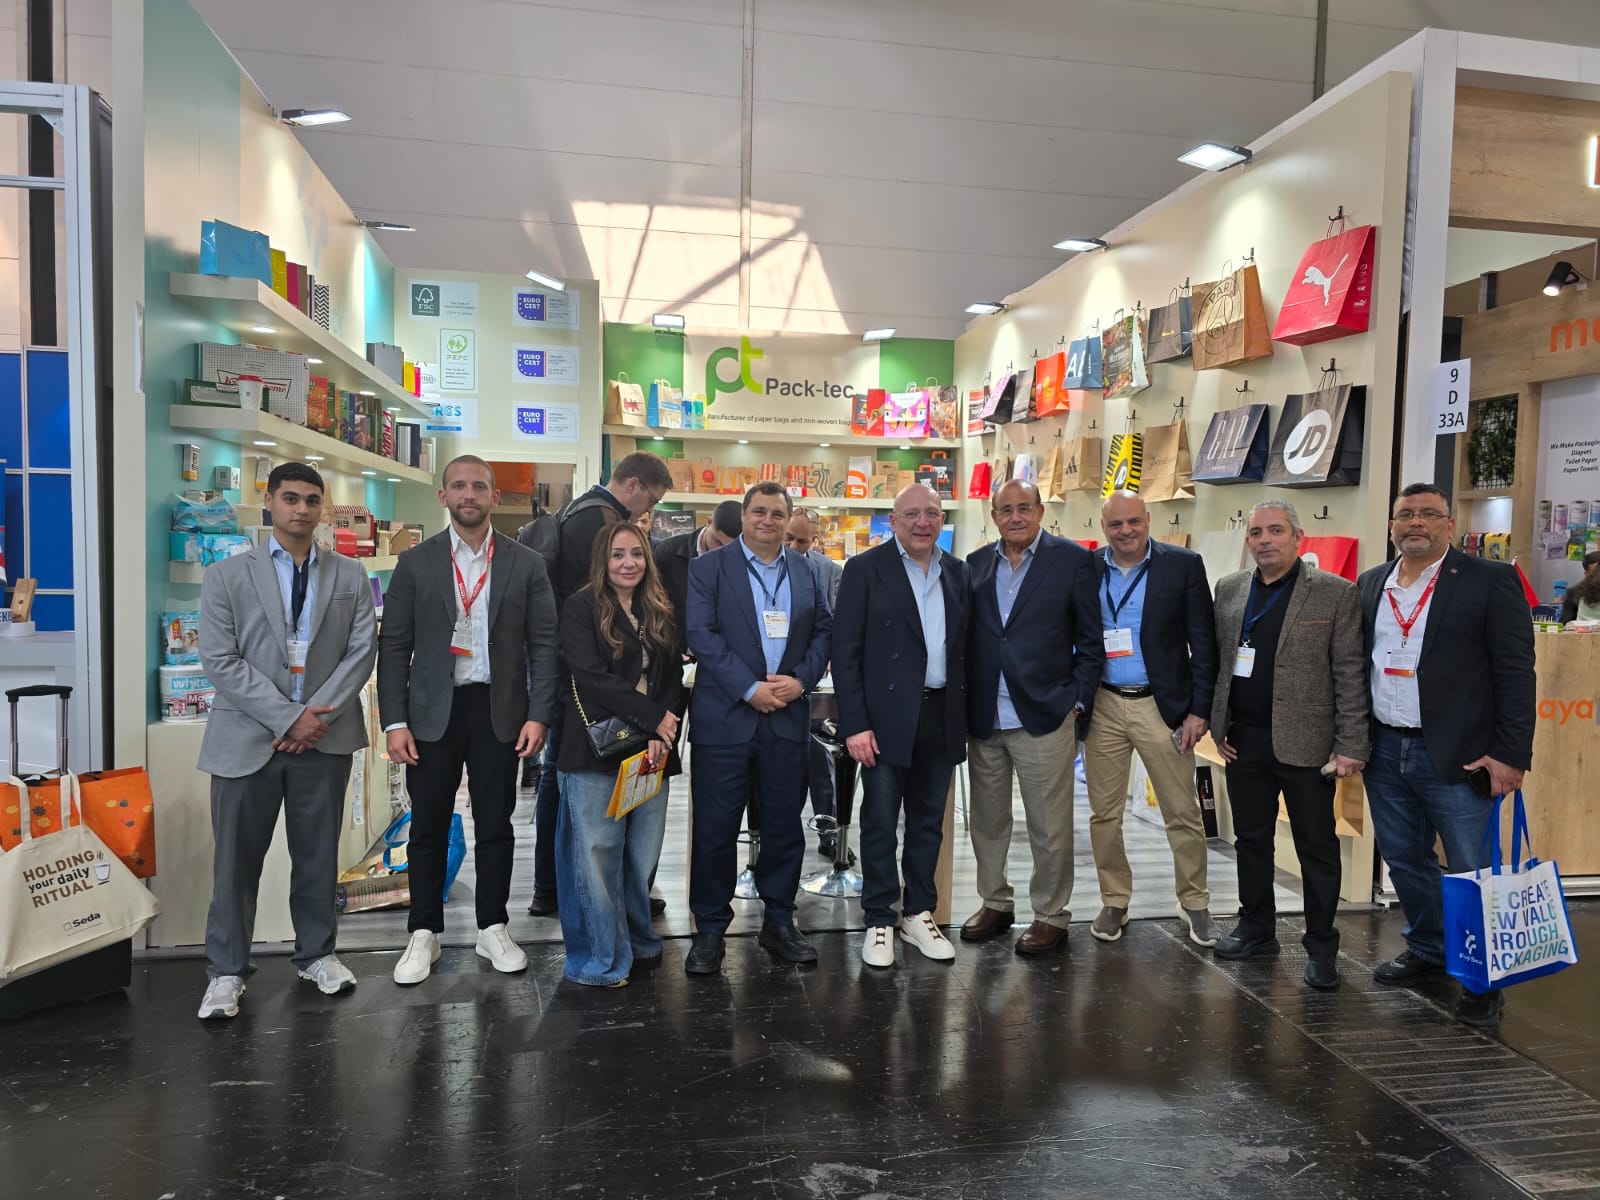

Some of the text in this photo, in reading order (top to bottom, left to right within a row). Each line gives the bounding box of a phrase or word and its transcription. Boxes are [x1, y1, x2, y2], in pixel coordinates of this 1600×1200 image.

[765, 377, 854, 398] Pack-tec
[1450, 368, 1459, 383] 9
[1448, 390, 1458, 405] D
[1438, 411, 1465, 428] 33A
[1207, 415, 1249, 460] GAP
[1288, 424, 1327, 460] JD
[172, 678, 209, 689] white
[22, 850, 95, 883] HOLDING
[28, 866, 90, 894] your daily
[32, 879, 94, 908] RITUAL
[72, 912, 102, 929] Seda
[1490, 939, 1569, 972] ACKAGING
